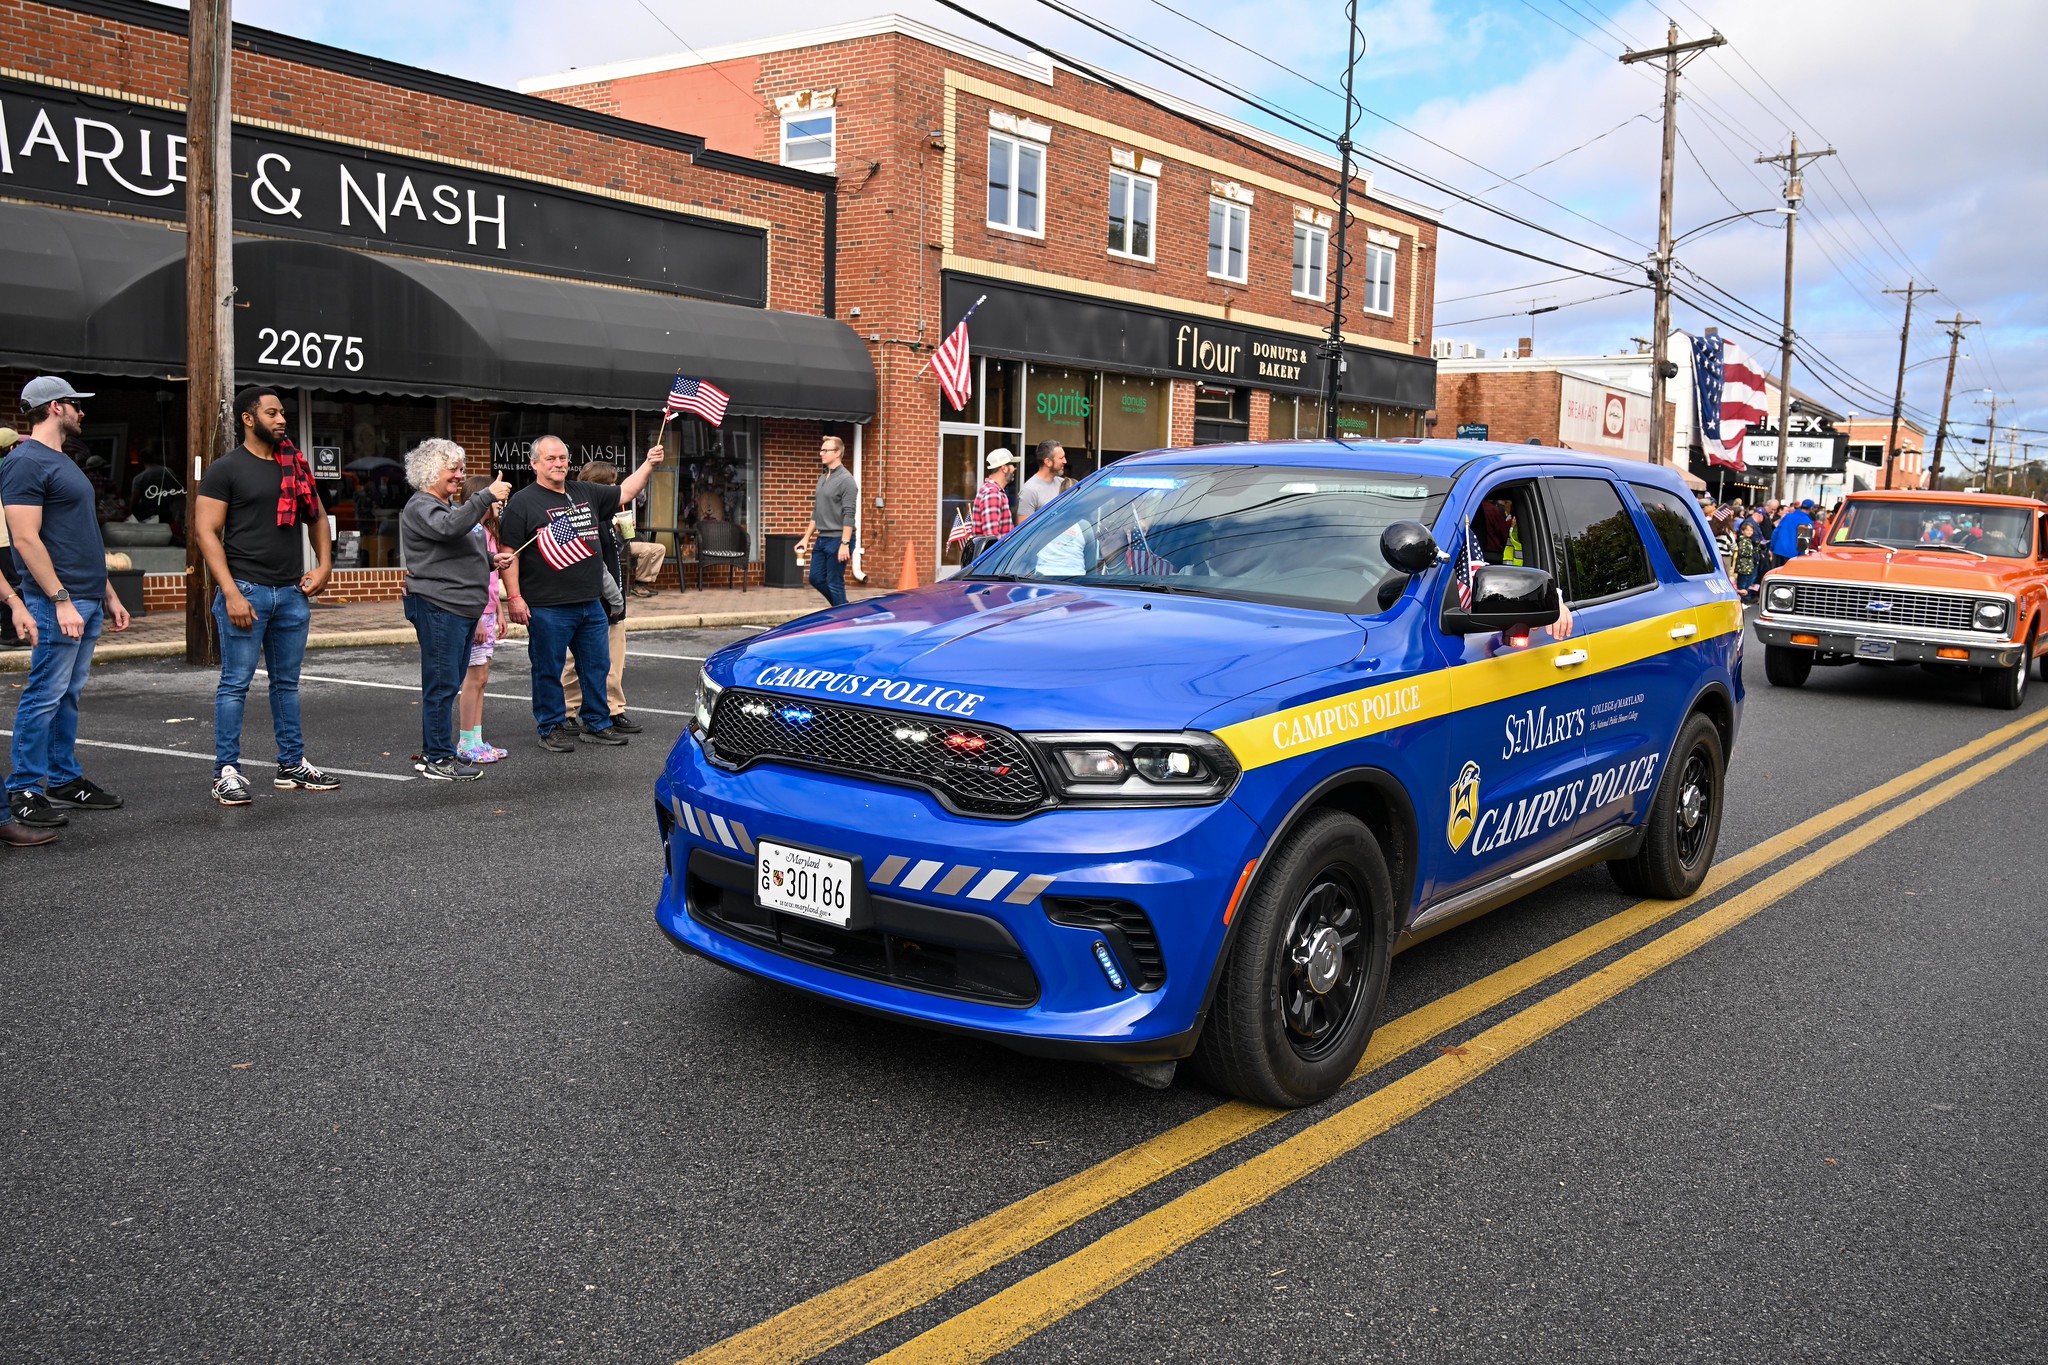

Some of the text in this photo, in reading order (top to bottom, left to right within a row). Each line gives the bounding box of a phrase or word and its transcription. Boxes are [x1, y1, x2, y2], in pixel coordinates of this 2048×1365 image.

[250, 153, 302, 219] &
[340, 163, 506, 249] NASH
[258, 327, 364, 372] 22675
[1176, 325, 1241, 373] flour
[1253, 342, 1307, 364] DONUTS &
[1259, 361, 1300, 380] BAKERY
[1037, 388, 1090, 421] spirits
[581, 444, 626, 465] NASH
[145, 484, 188, 506] Open
[755, 666, 985, 717] CAMPUS POLICE
[1591, 700, 1614, 716] COLLEGE
[1617, 693, 1645, 708] MARYLAND
[1272, 684, 1421, 750] CAMPUS POLICE
[1471, 752, 1660, 857] CAMPUS POLICE
[785, 852, 821, 870] Maryland
[786, 867, 845, 909] 30186
